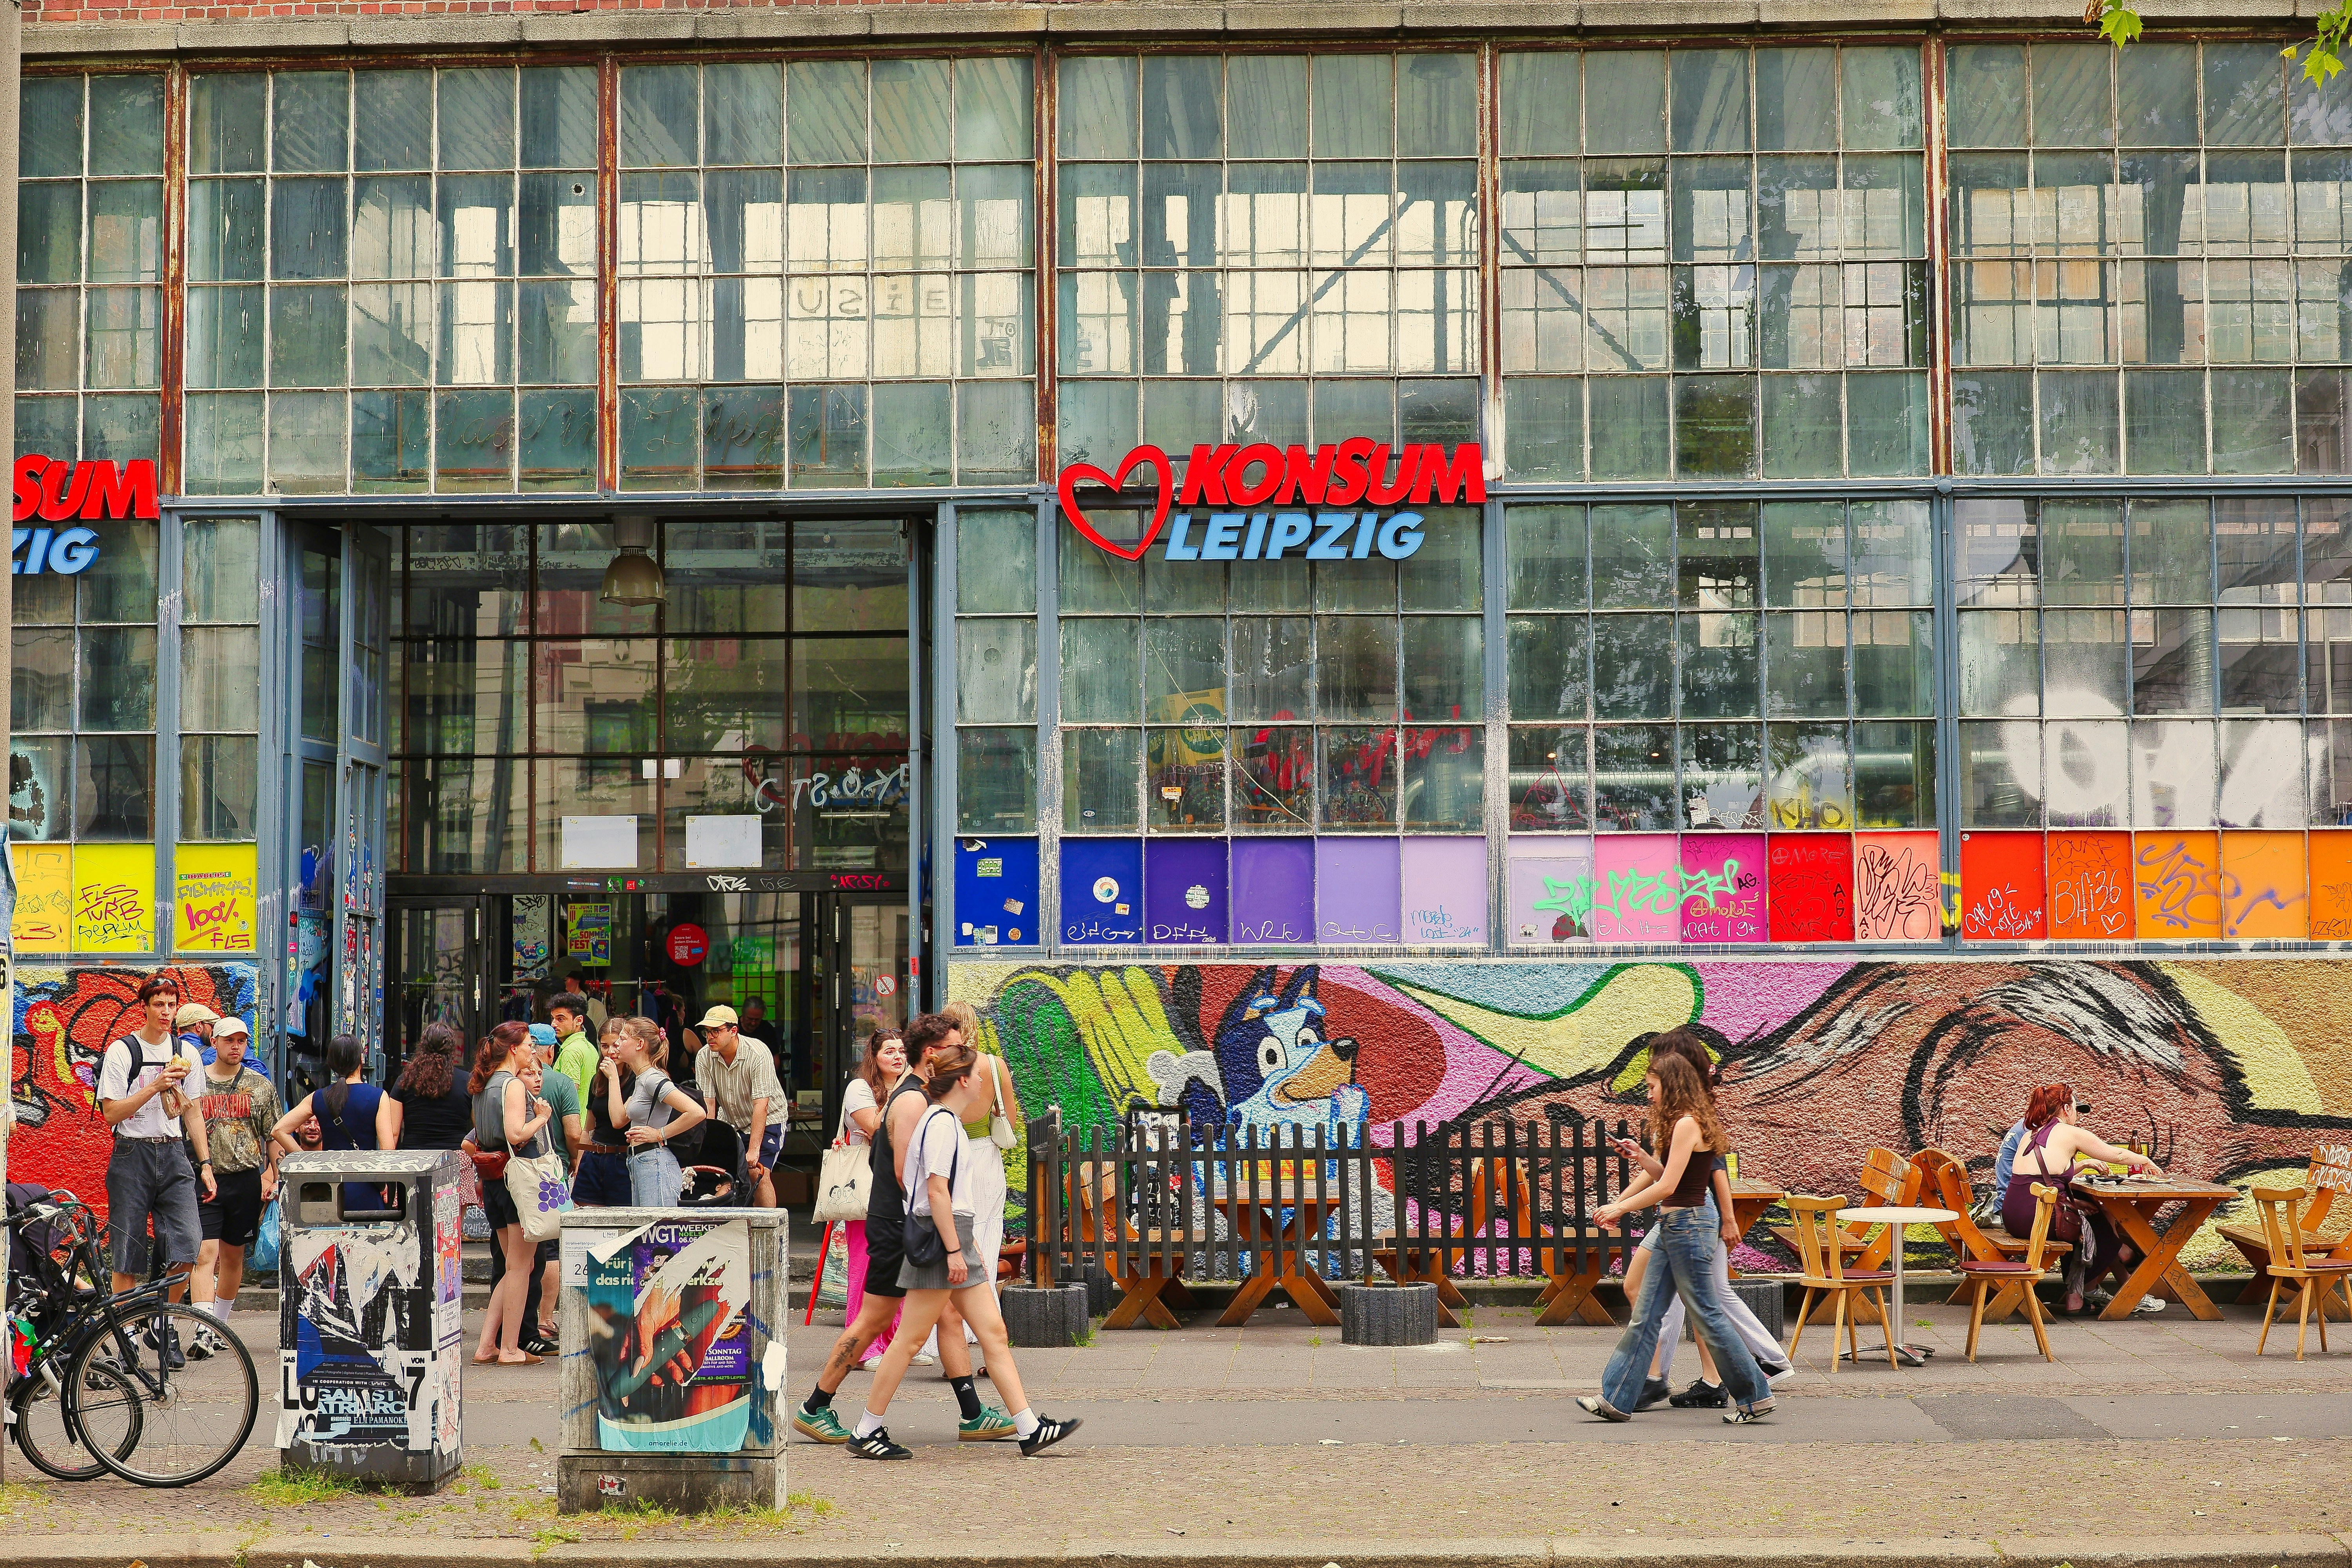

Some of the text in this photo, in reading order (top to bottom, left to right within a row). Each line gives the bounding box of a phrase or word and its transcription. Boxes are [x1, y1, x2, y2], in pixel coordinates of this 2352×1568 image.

[1178, 437, 1486, 506] KONSUM
[1165, 511, 1425, 561] LEIPZIG
[185, 898, 239, 931] 100%
[210, 933, 250, 949] FLS
[579, 931, 609, 939] SOMMER
[570, 940, 590, 949] FEST
[641, 1225, 678, 1243] WGT
[606, 1258, 626, 1269] Für
[596, 1274, 619, 1285] das
[406, 1367, 425, 1411] 7
